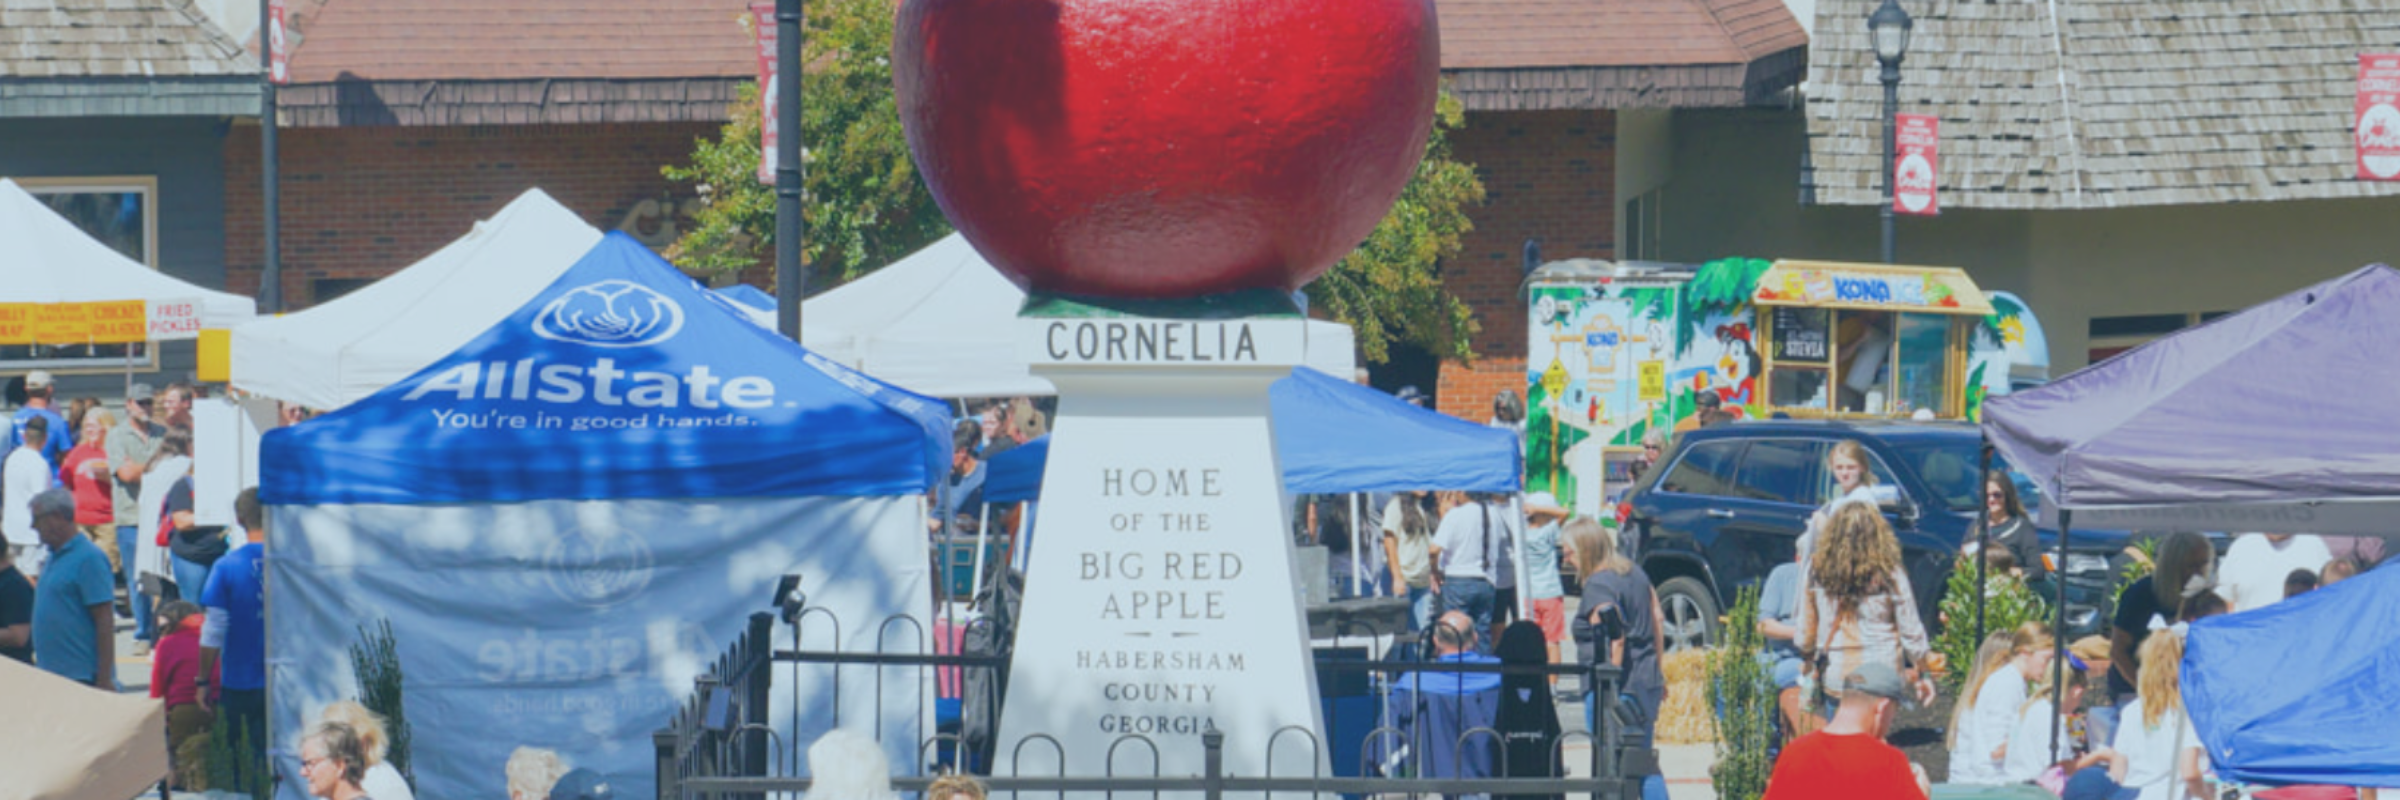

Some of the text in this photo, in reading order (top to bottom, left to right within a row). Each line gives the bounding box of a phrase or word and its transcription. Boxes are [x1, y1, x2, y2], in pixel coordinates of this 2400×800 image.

[1833, 275, 1925, 303] KONA ICE
[156, 304, 193, 317] FRIED
[150, 318, 201, 333] PICKLES
[1046, 321, 1258, 361] CORNELIA
[1785, 340, 1825, 358] STEVIA
[400, 357, 776, 409] Allstate
[431, 408, 758, 431] You're in good hands.
[1102, 468, 1222, 497] HOME
[1110, 513, 1212, 531] OF THE
[1080, 552, 1243, 580] BIG RED
[1100, 591, 1226, 619] APPLE
[1076, 650, 1245, 671] HABERSHAM
[1103, 682, 1216, 702] COUNTY
[1100, 714, 1218, 734] GEORGIA
